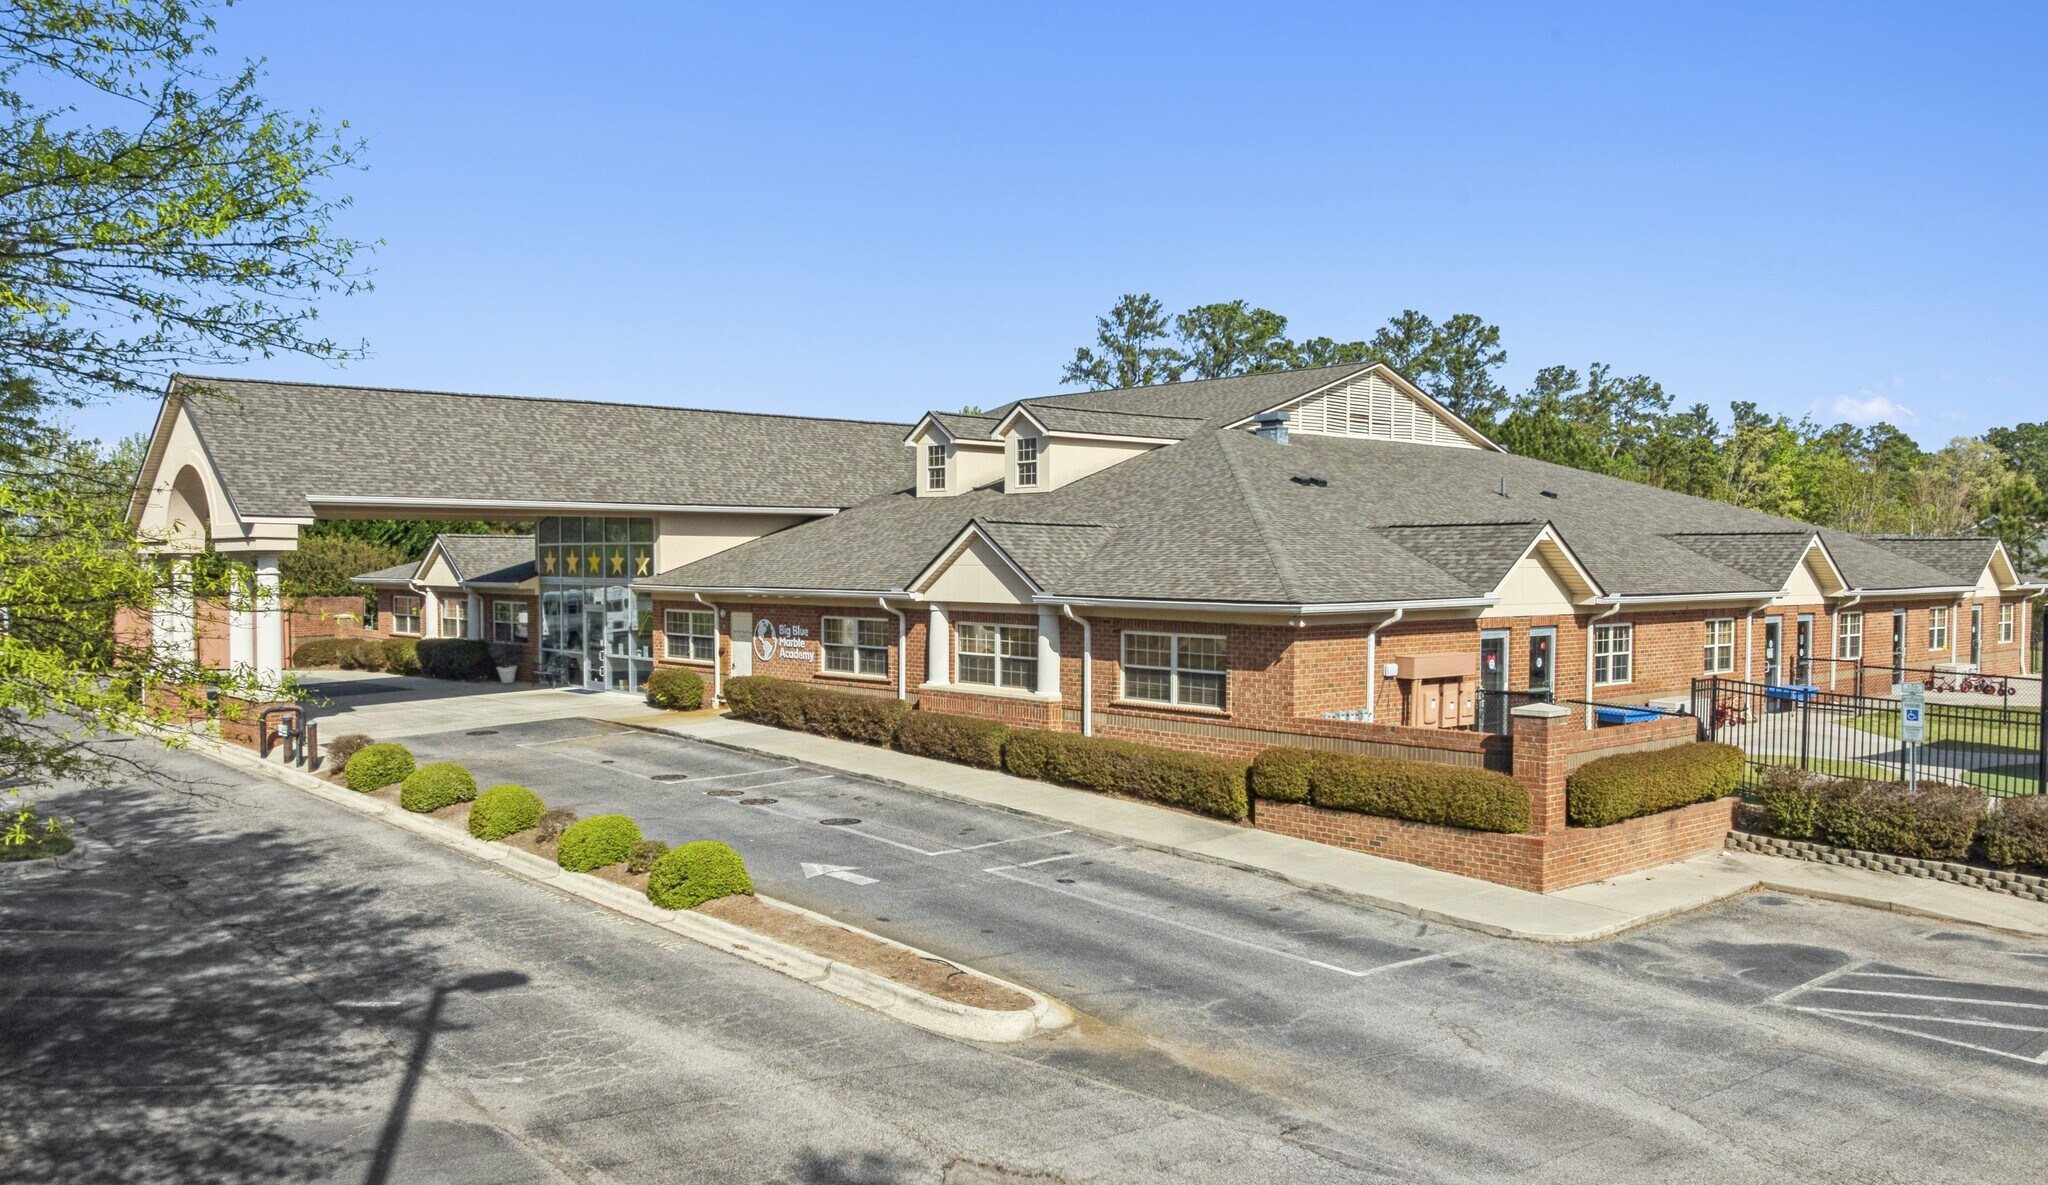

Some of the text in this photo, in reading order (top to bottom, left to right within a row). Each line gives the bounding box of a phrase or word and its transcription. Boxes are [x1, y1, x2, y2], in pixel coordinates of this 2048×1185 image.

[779, 624, 809, 638] Big Blue
[779, 637, 805, 648] Marble
[779, 648, 814, 663] Academy
